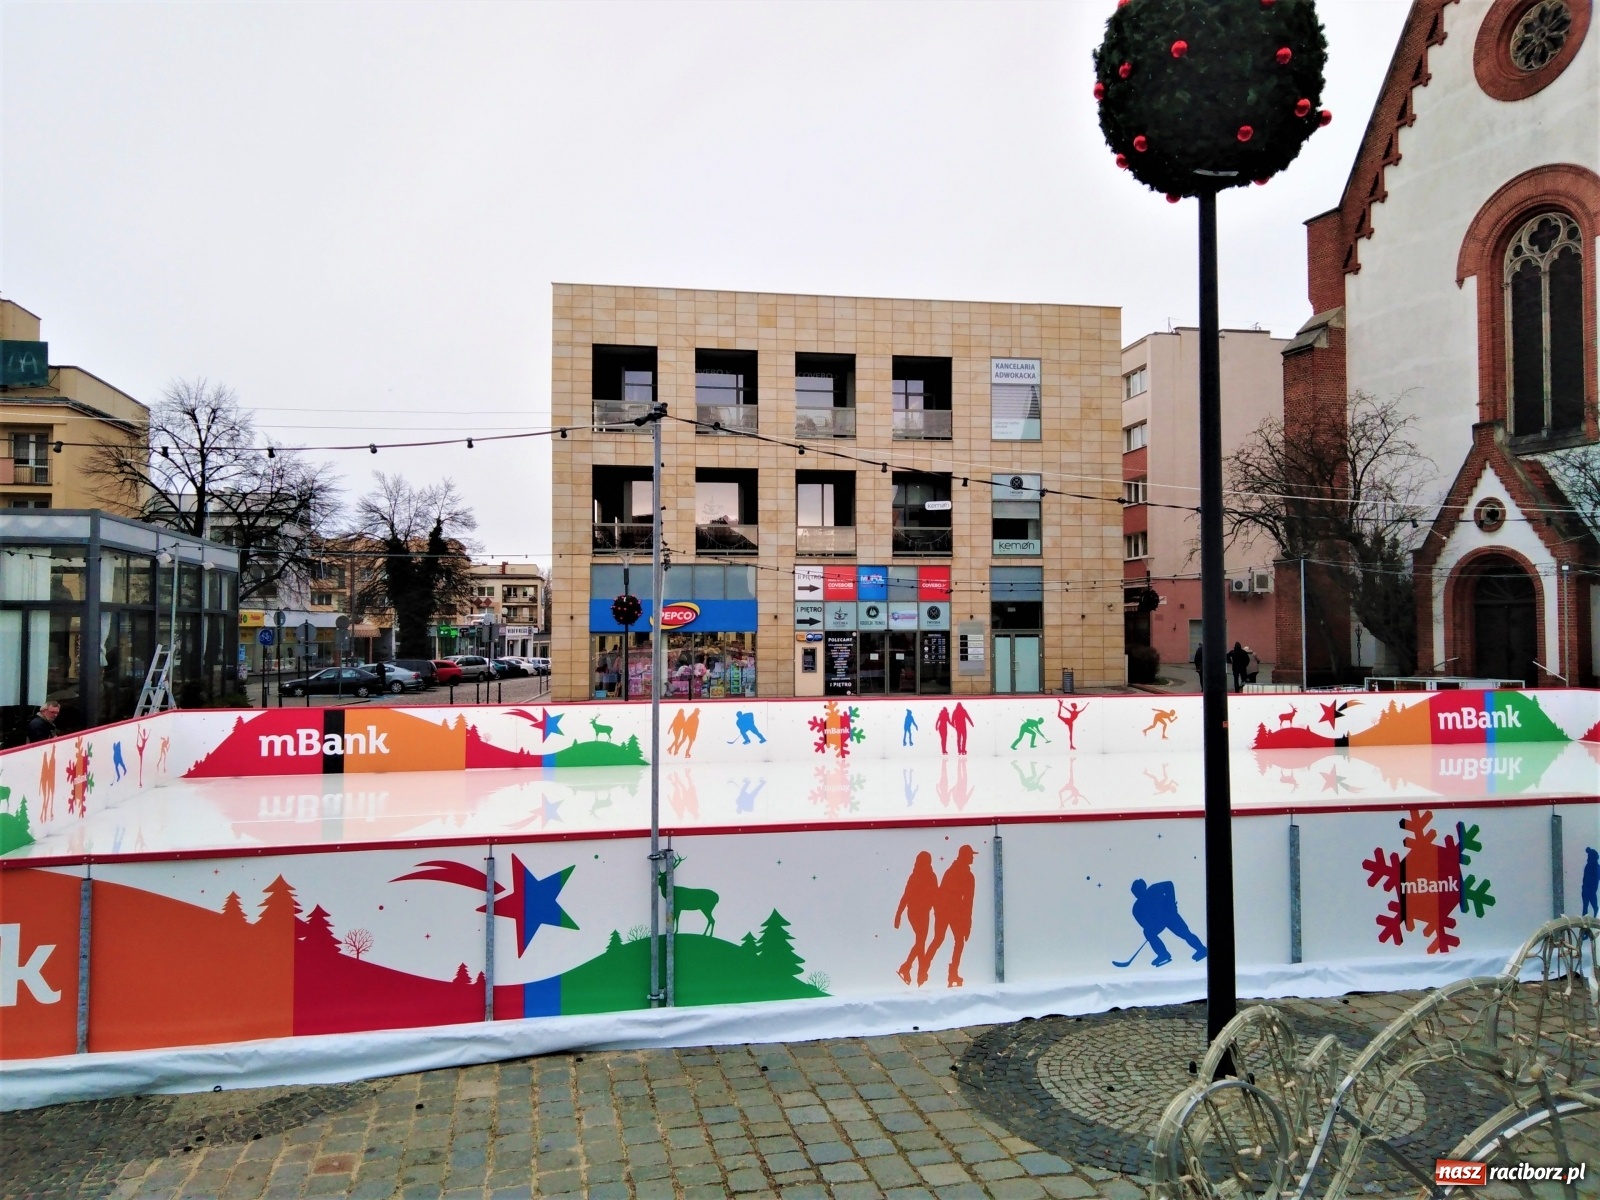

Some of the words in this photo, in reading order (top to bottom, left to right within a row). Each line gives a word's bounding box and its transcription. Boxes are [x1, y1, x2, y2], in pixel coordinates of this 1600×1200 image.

[995, 362, 1036, 370] KANCELARIA
[995, 371, 1036, 379] ADWOKACKA
[800, 606, 823, 614] PIĘTRO
[1437, 704, 1522, 730] mBank
[824, 726, 850, 735] mBank
[258, 725, 390, 757] mBank
[1401, 876, 1459, 895] mBank
